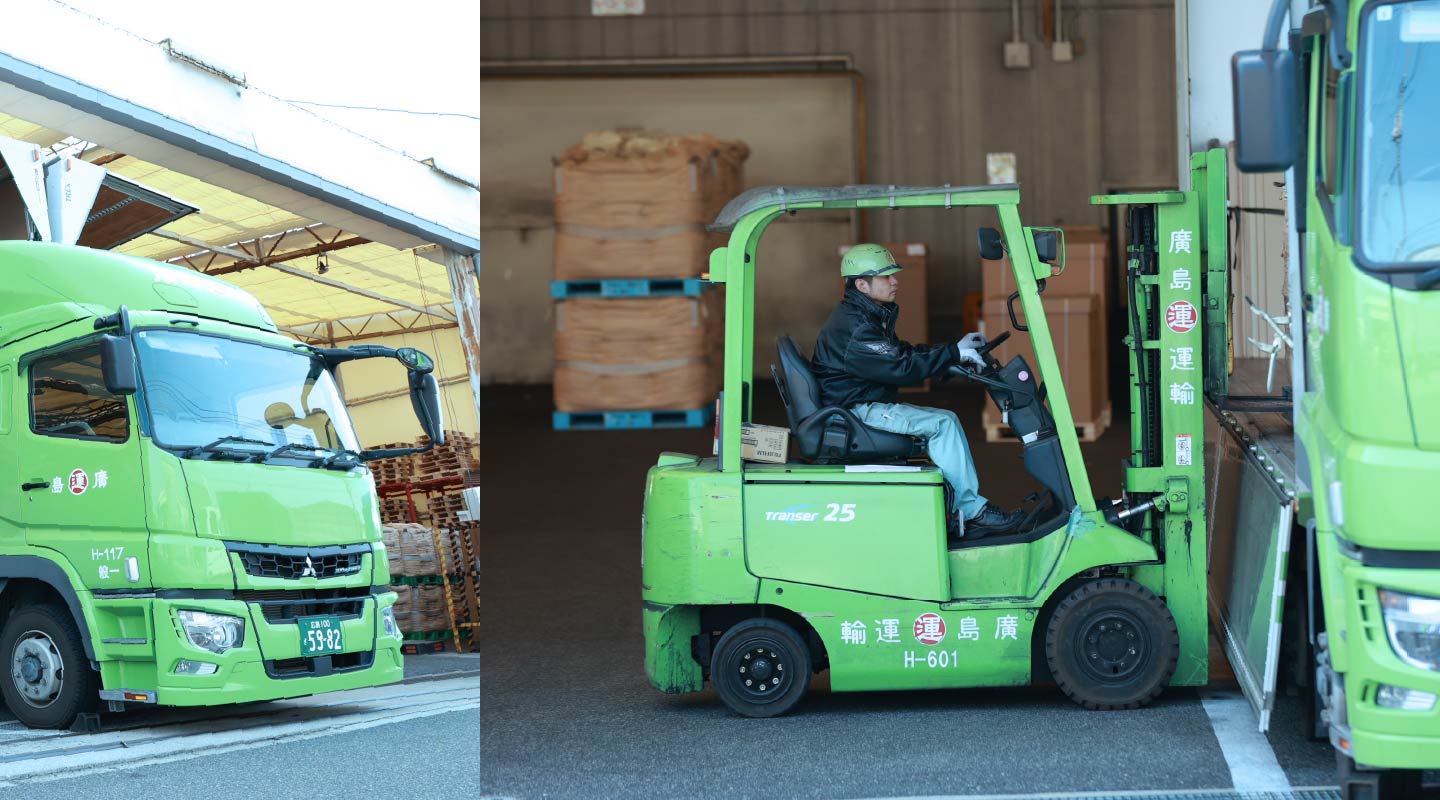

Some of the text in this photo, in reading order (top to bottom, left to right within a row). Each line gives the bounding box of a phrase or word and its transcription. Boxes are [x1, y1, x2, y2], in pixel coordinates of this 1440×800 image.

[823, 502, 857, 522] 25
[91, 547, 125, 560] H-117
[307, 628, 342, 652] 59-82
[904, 650, 959, 668] H-601
